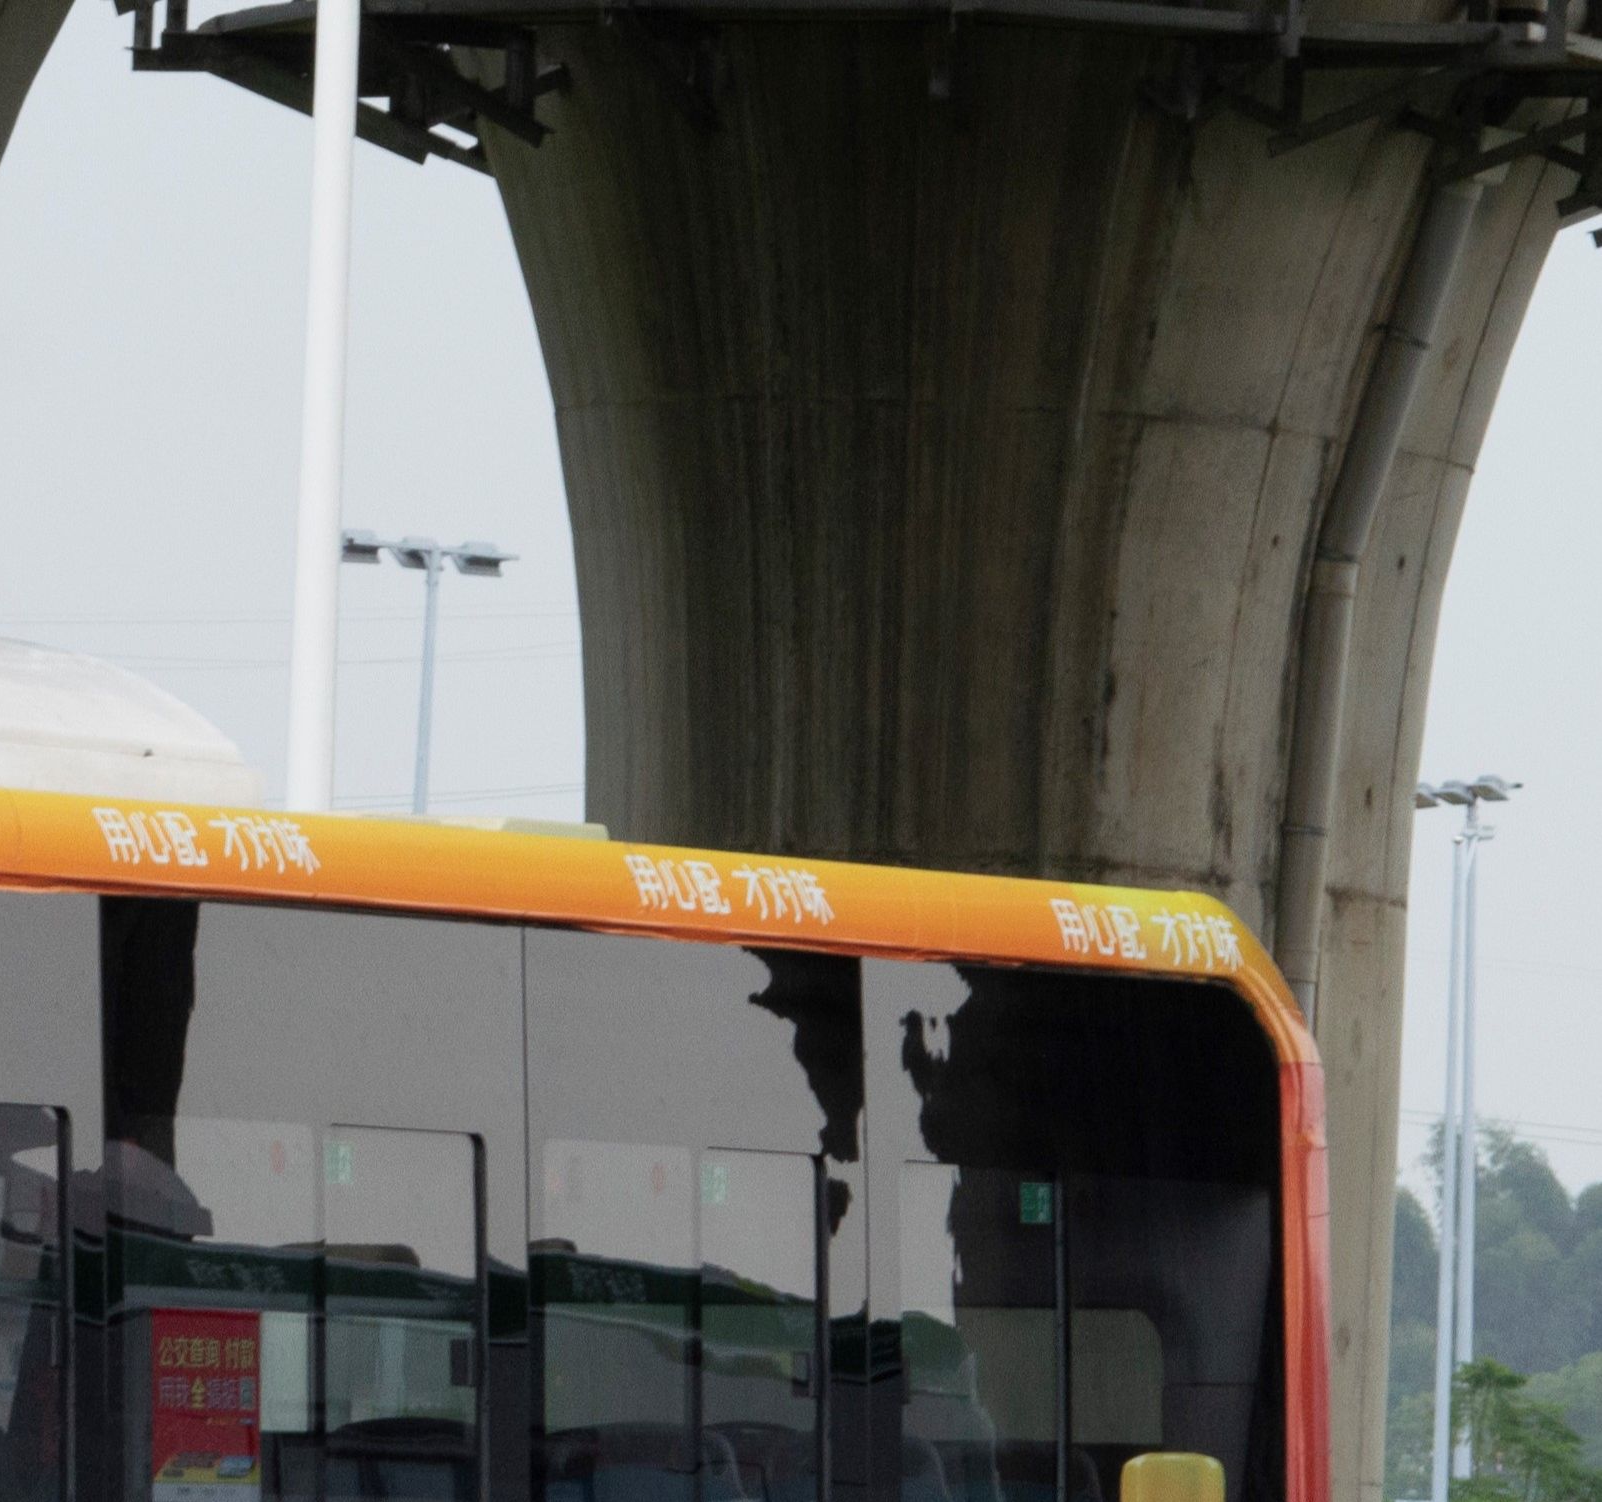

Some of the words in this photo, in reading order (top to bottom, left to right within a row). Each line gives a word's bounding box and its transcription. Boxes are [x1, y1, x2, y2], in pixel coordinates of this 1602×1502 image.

[91, 805, 205, 869] 用心配
[207, 814, 321, 876] 才对味
[625, 854, 732, 915] 用心配
[741, 864, 835, 926] 才对味
